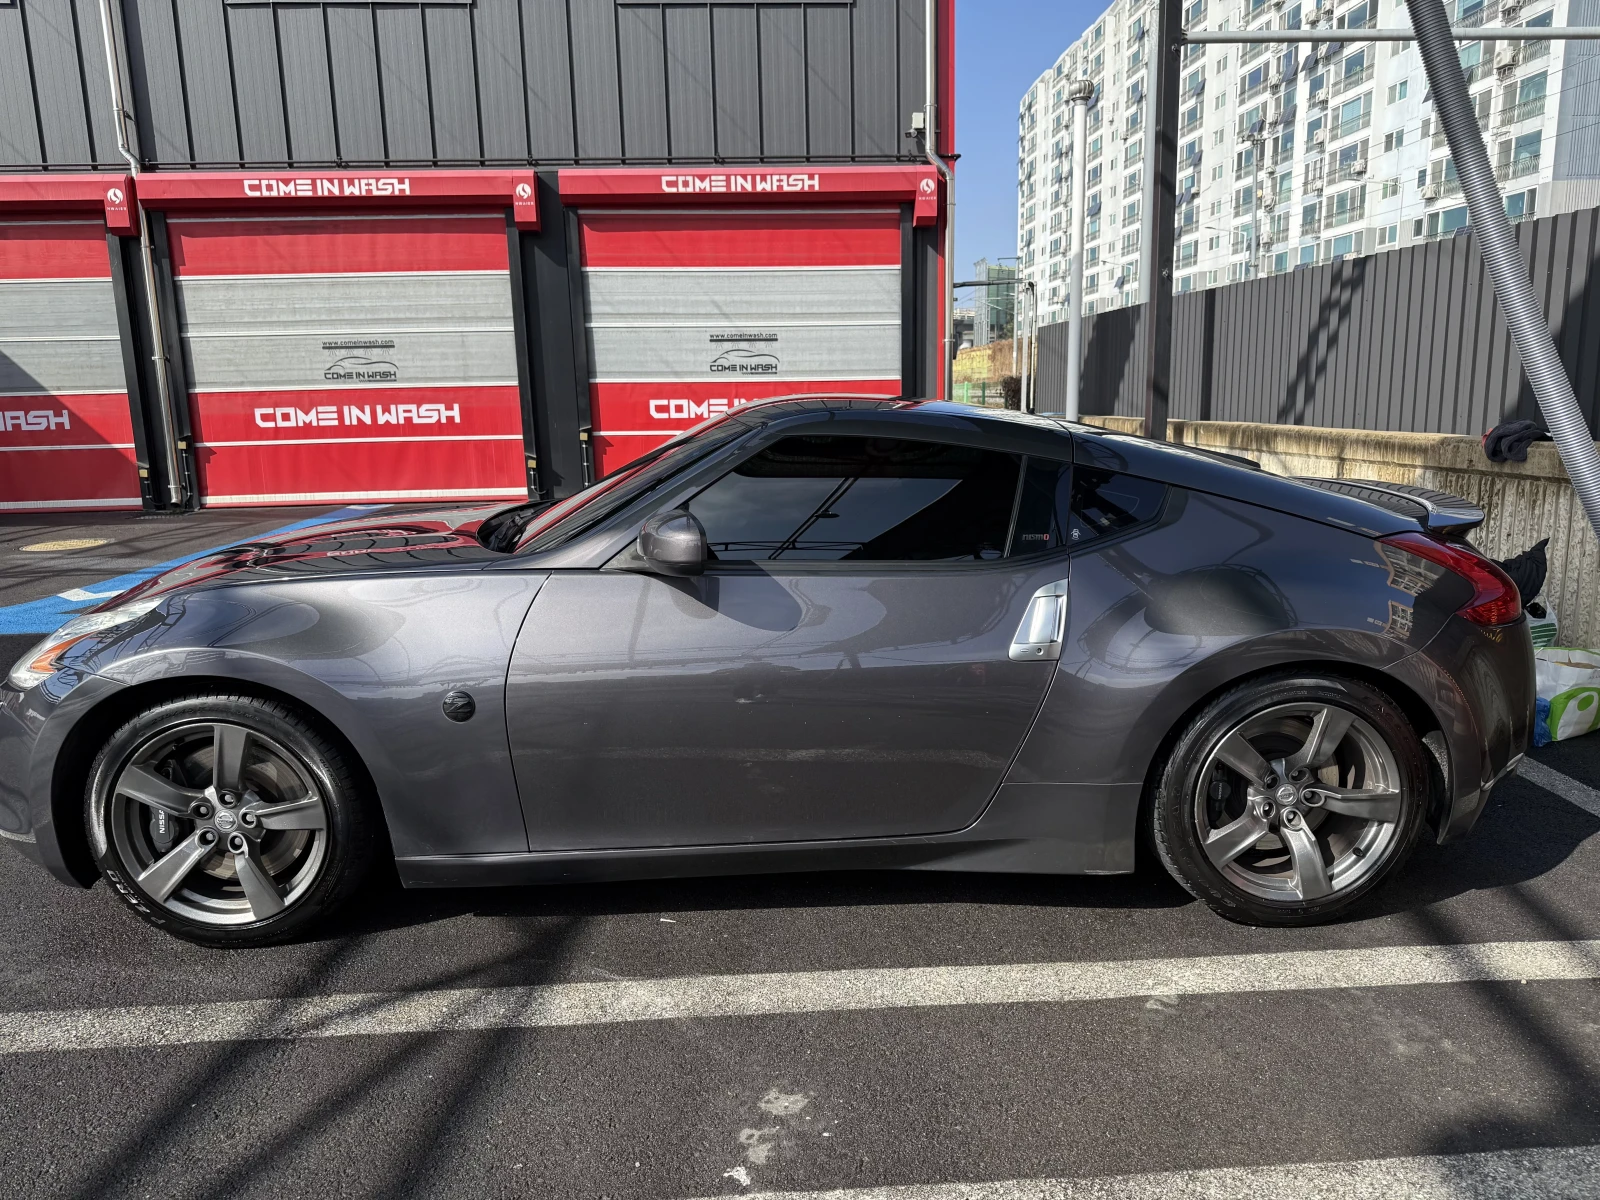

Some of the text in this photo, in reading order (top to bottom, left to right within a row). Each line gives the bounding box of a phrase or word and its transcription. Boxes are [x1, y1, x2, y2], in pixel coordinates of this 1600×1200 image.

[243, 178, 411, 197] COME IN WASH
[661, 174, 820, 193] COME IN WASH
[321, 339, 395, 347] www.comeinwash.com
[324, 371, 397, 380] COME IN WASH
[709, 363, 778, 372] COME IN WASH
[254, 403, 461, 428] COME IN WASH
[649, 398, 729, 419] COME
[0, 409, 71, 431] ASH
